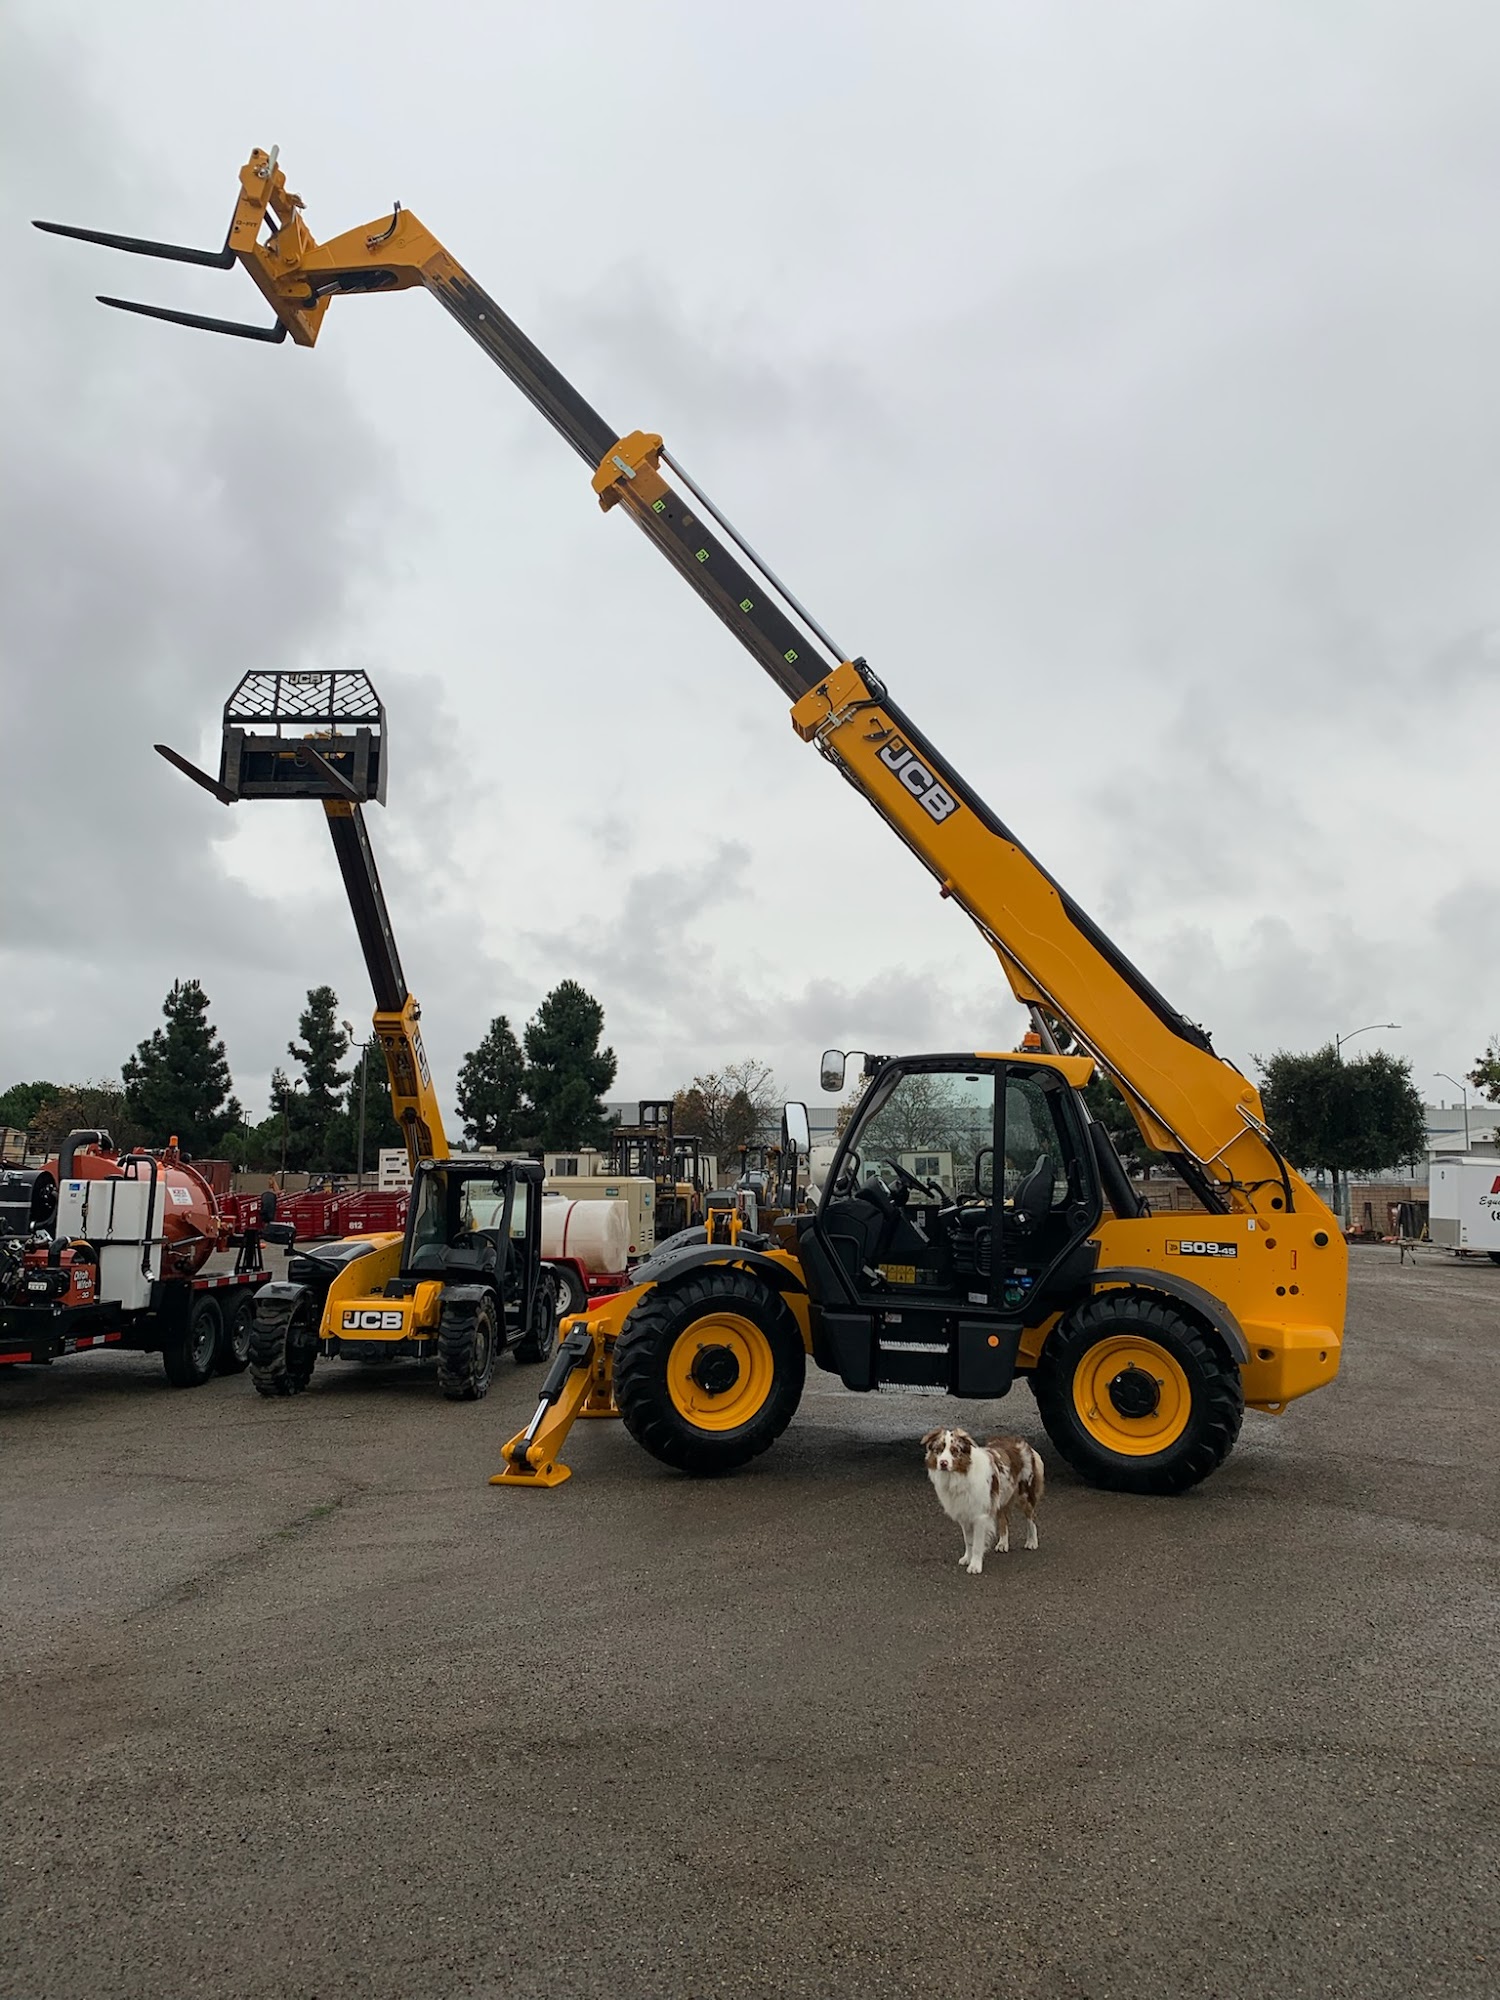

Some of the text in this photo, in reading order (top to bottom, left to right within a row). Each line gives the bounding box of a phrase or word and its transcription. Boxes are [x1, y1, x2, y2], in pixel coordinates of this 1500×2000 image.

[289, 673, 322, 684] JCB
[879, 744, 956, 821] JCB
[412, 1033, 430, 1089] JCB
[1180, 1241, 1237, 1255] 509-45
[73, 1270, 89, 1281] Ditch
[76, 1279, 92, 1290] Witch
[343, 1311, 402, 1330] JCB
